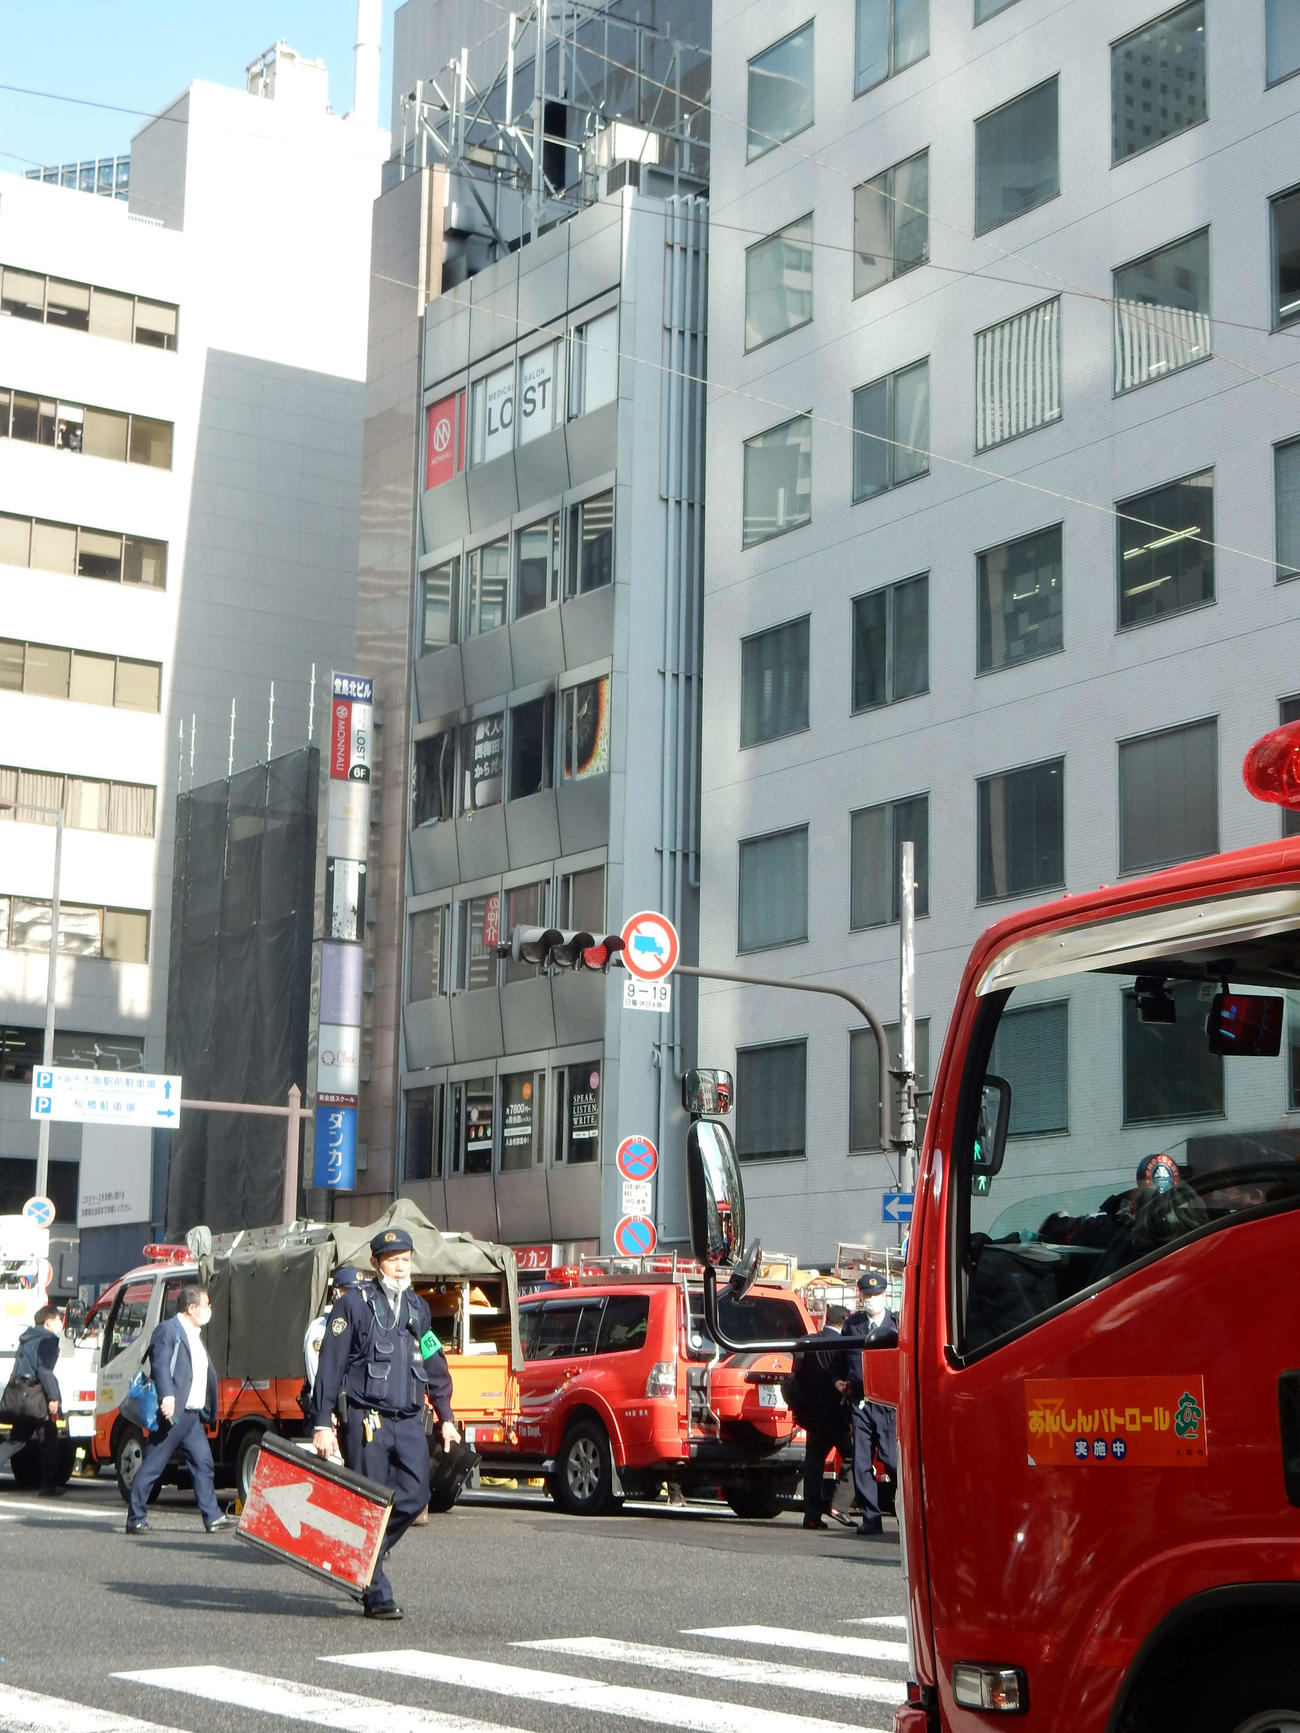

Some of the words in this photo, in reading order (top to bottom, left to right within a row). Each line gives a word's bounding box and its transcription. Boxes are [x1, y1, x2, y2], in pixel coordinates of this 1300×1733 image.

[524, 367, 545, 382] SALON
[487, 376, 551, 437] LOST
[334, 678, 371, 699] 堂島北ビル
[356, 729, 366, 760] LOST
[353, 767, 366, 778] 6F
[327, 1112, 346, 1185] ダンカン
[515, 1250, 549, 1268] ンカン
[1028, 1407, 1170, 1433] あんしんパトロール
[1075, 1440, 1125, 1457] 実施中
